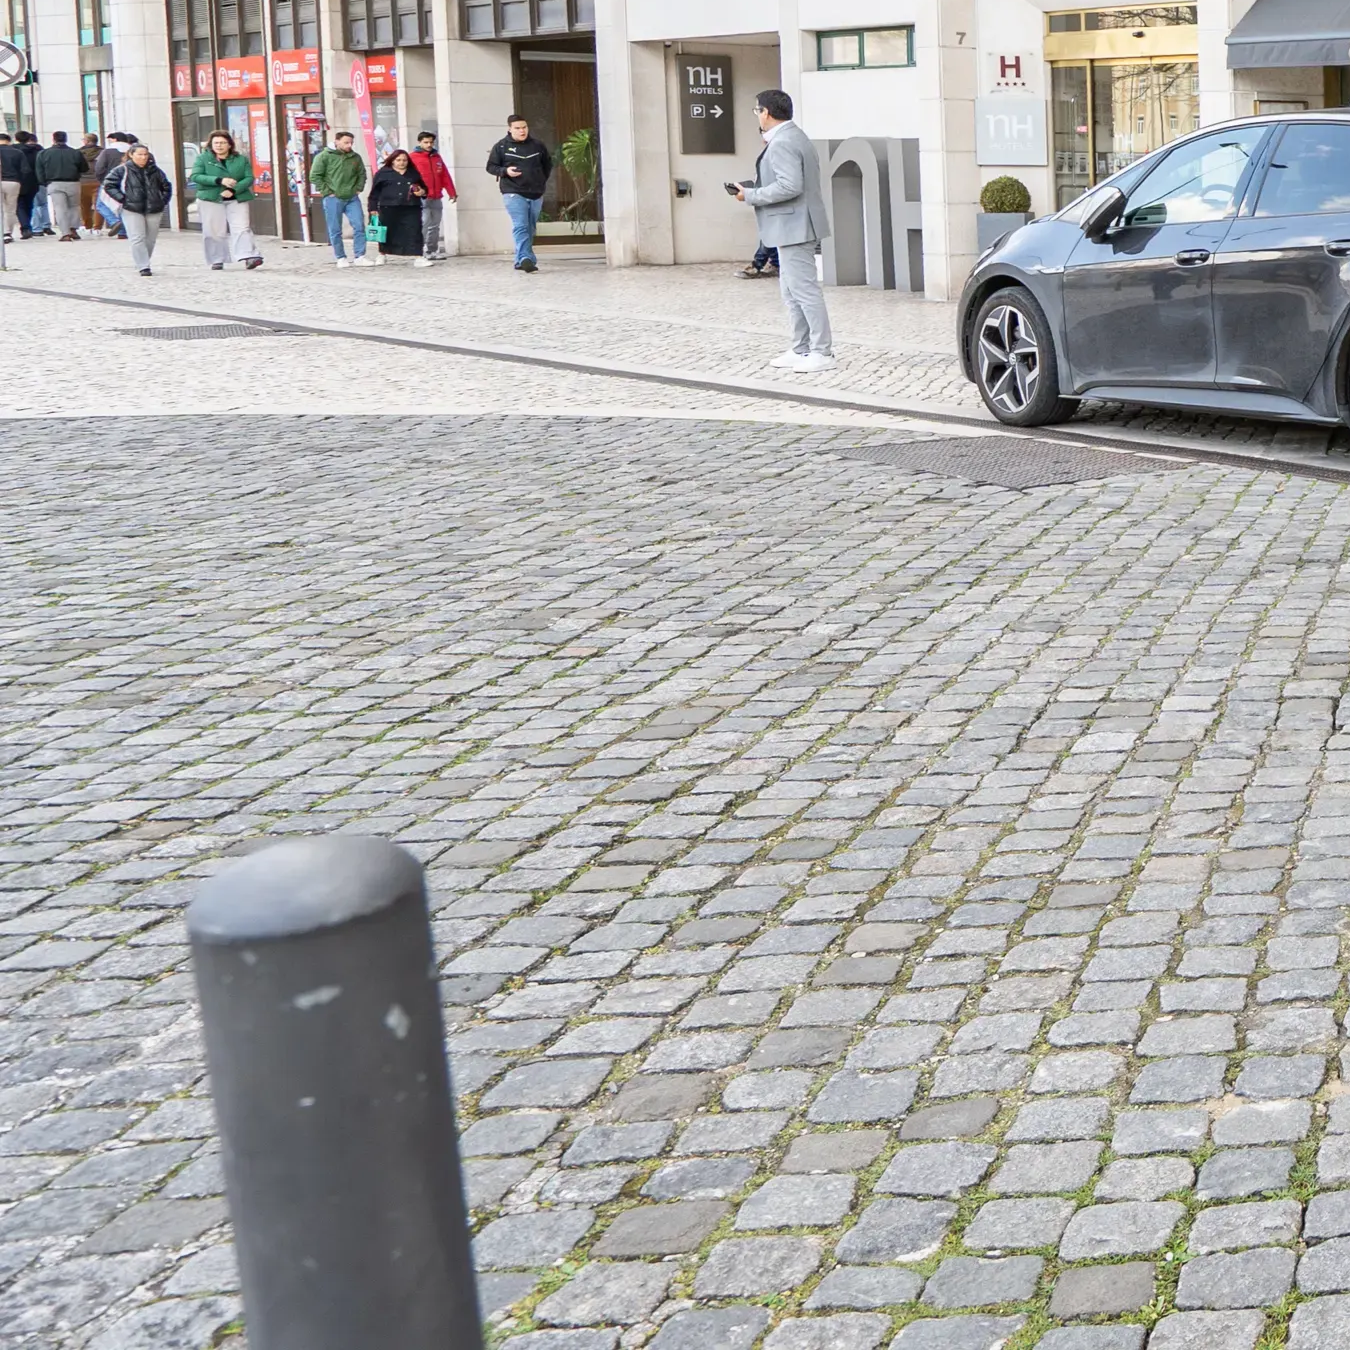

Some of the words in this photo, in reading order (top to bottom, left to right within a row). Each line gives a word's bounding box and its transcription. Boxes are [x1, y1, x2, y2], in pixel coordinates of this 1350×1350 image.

[956, 32, 967, 45] 7
[1000, 55, 1021, 78] H
[689, 87, 724, 95] HOTELS
[693, 106, 702, 116] P
